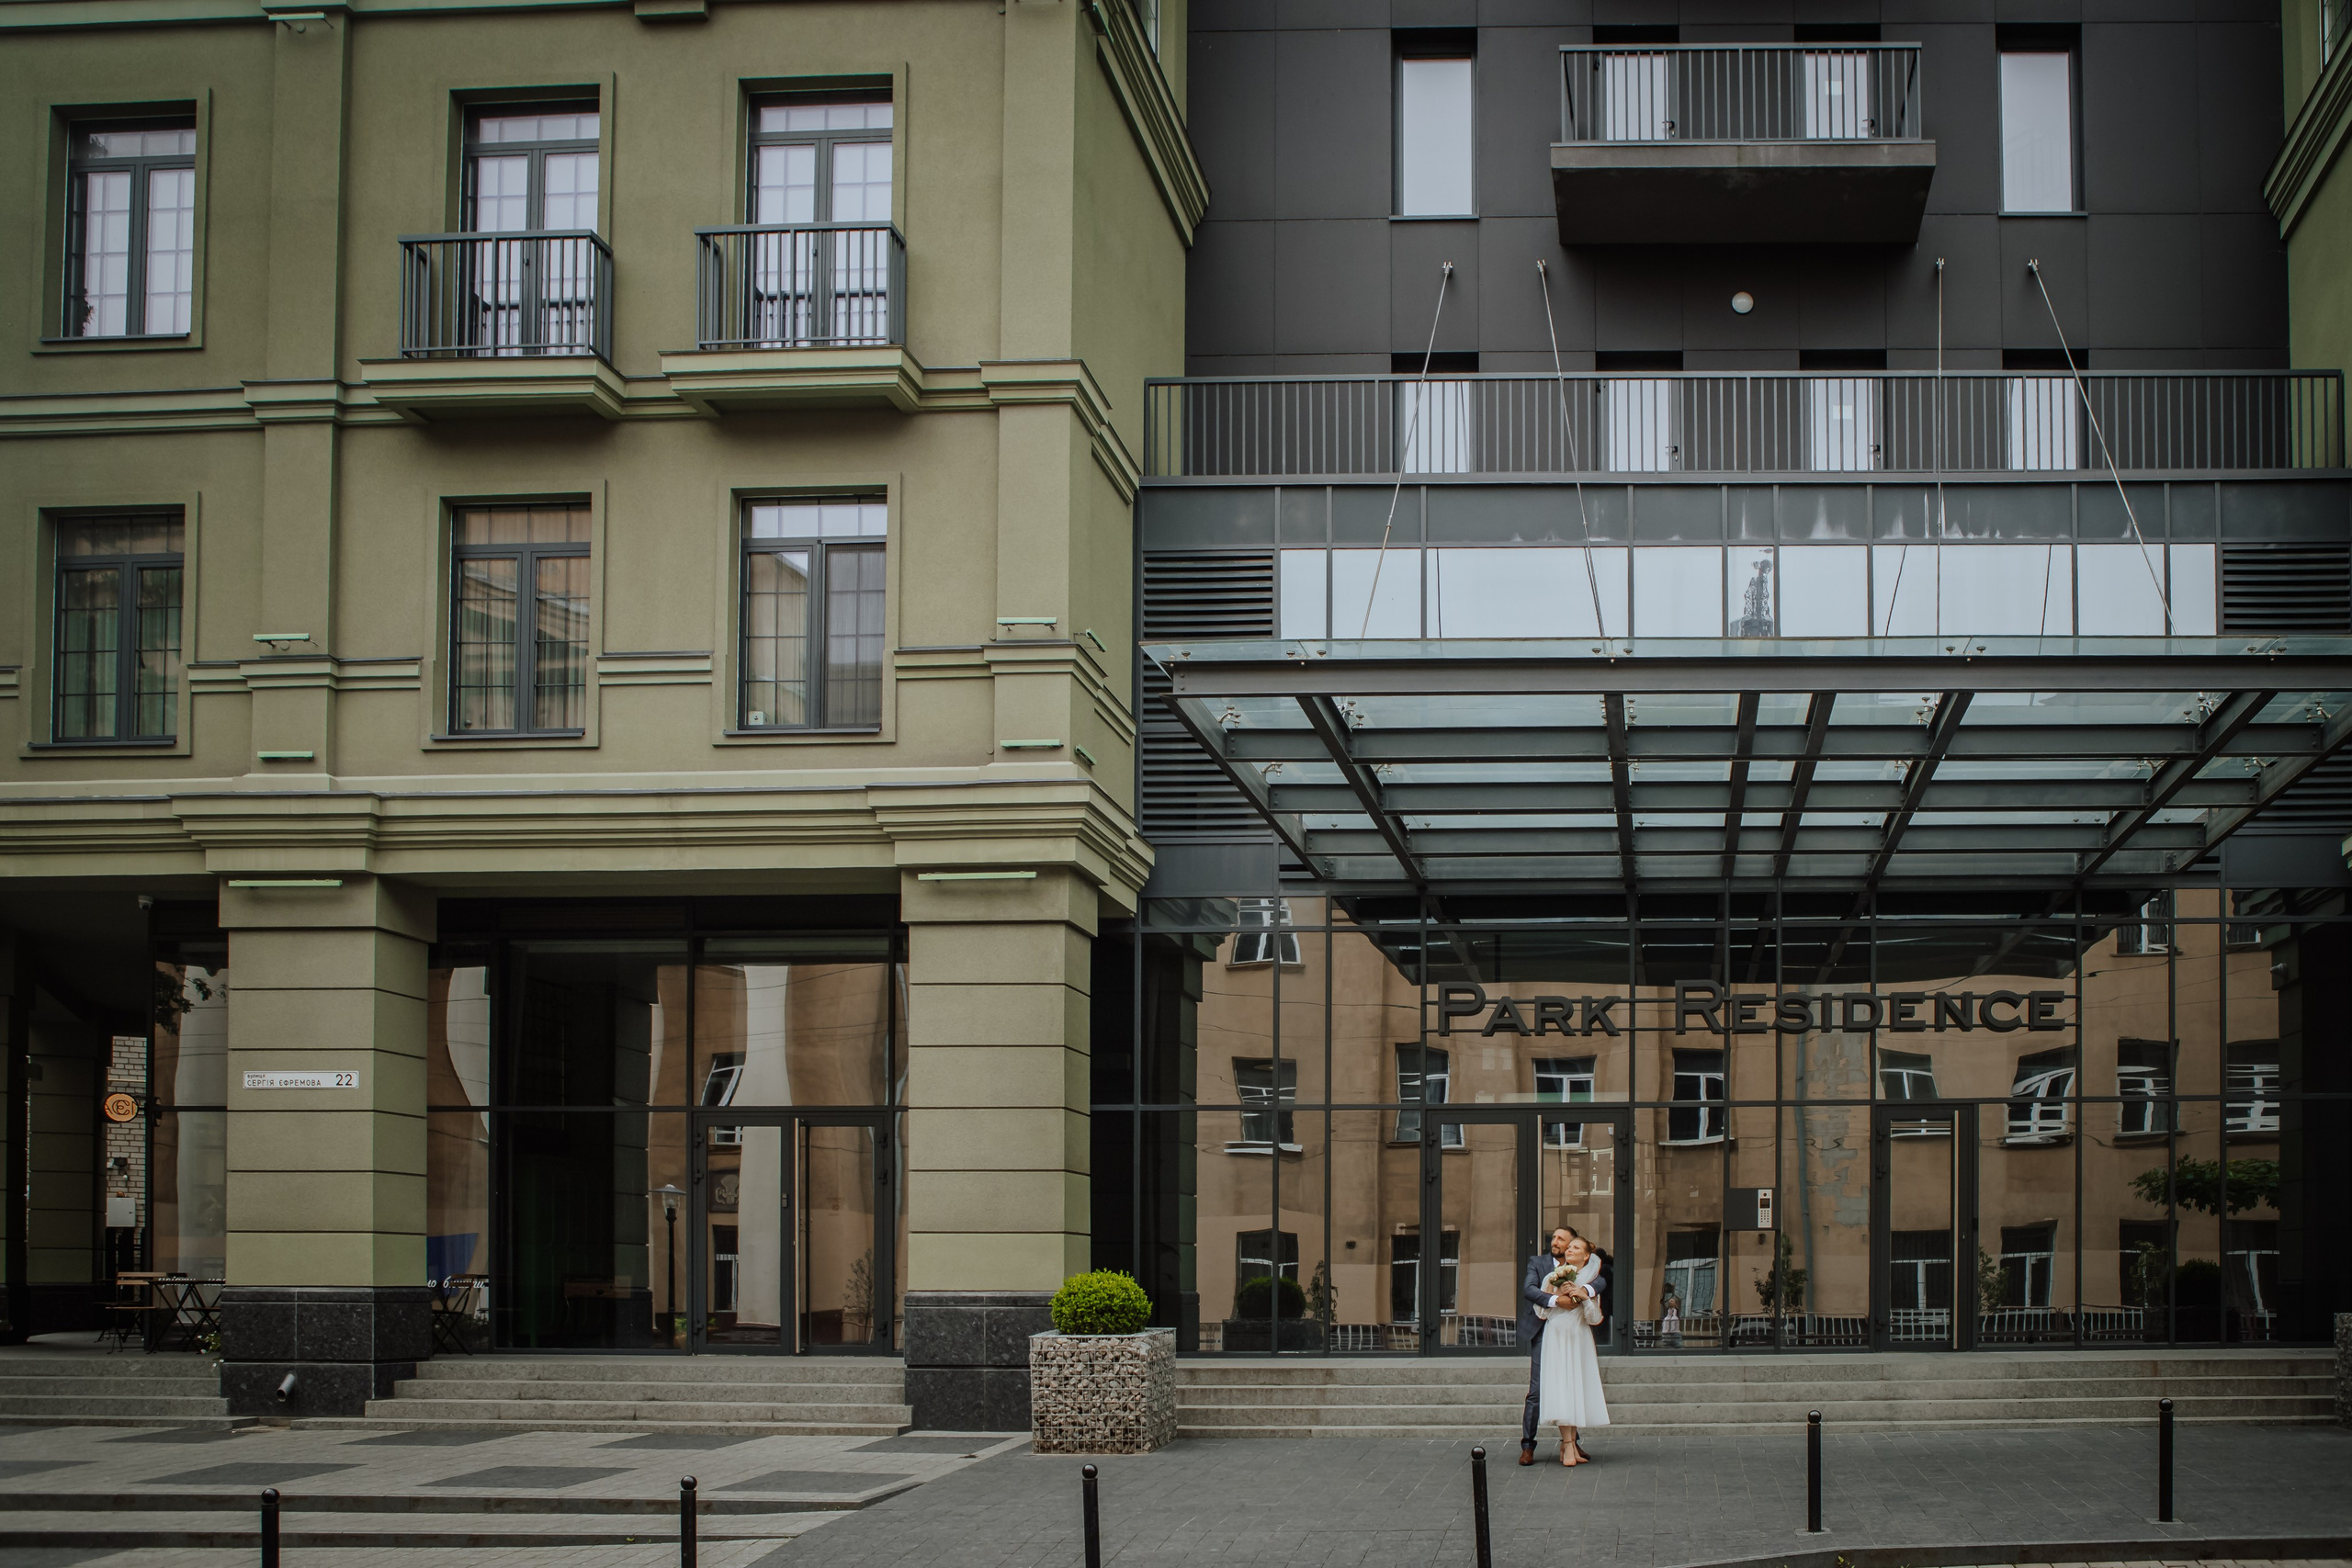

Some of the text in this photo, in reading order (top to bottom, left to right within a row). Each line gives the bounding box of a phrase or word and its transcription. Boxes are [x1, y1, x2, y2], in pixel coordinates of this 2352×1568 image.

[1437, 978, 2066, 1037] PARK RESIDENCE
[335, 1073, 353, 1086] 22
